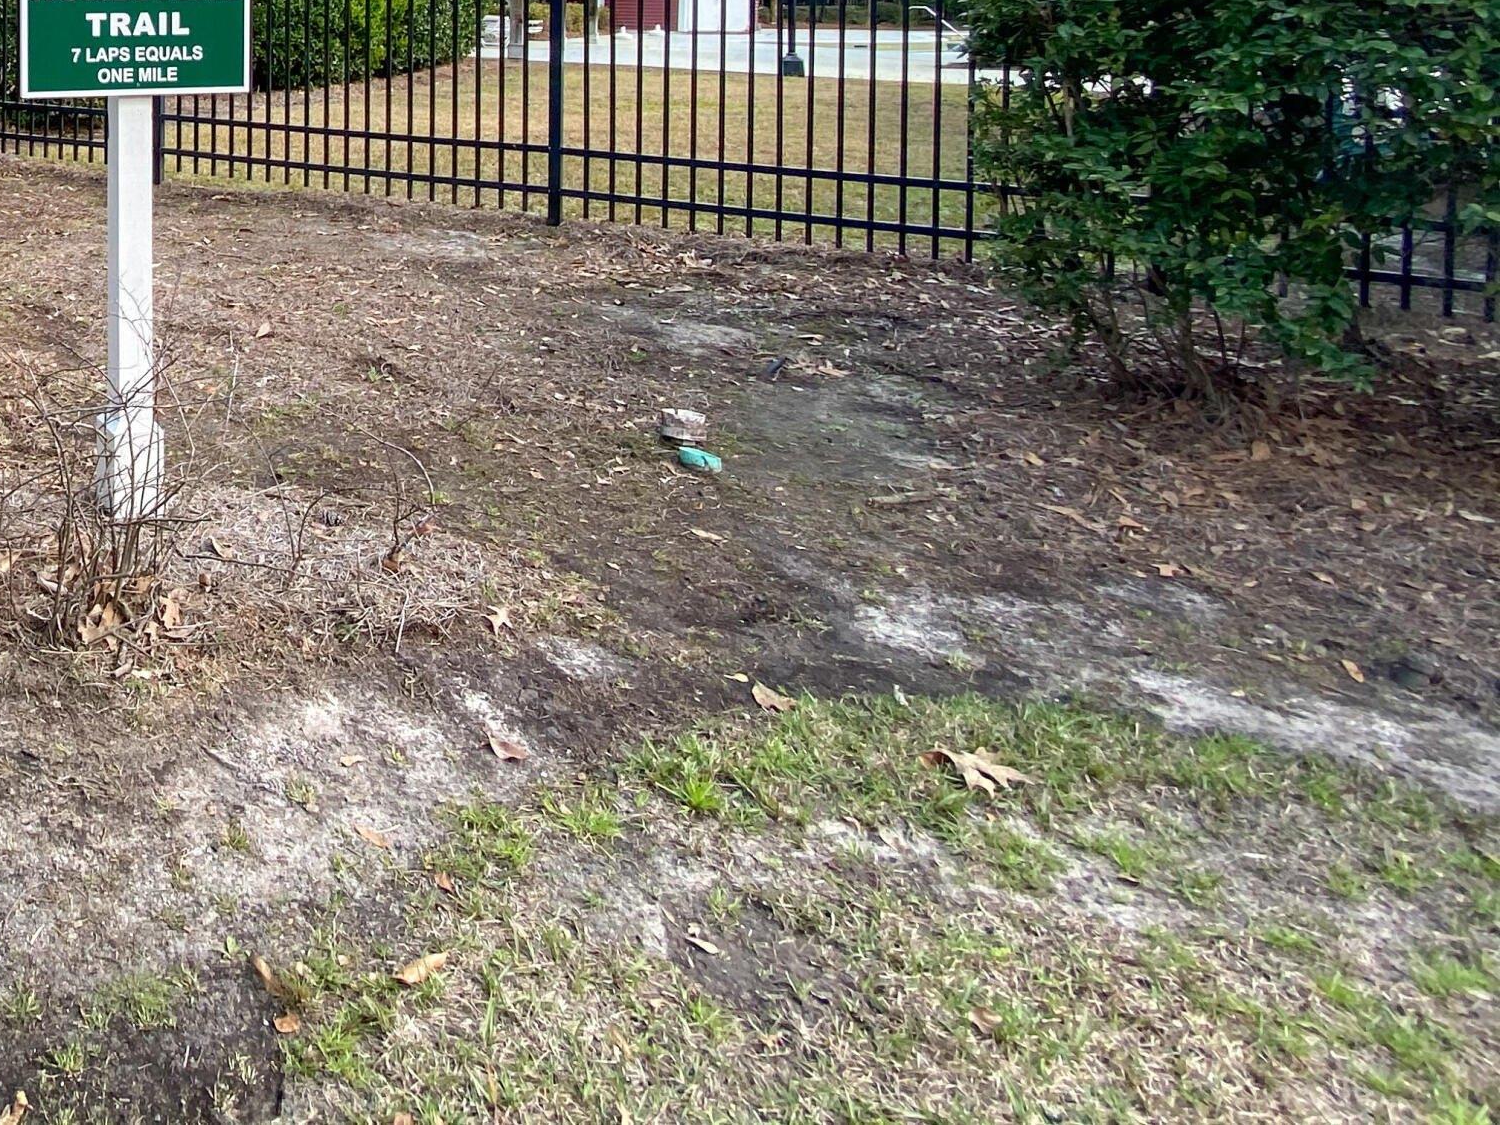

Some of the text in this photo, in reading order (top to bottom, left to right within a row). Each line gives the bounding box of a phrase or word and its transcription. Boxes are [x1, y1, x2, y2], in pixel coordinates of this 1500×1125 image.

[85, 12, 190, 37] TRAIL
[71, 45, 203, 63] 7 LAPS EQUALS
[97, 67, 178, 83] ONE MILE
